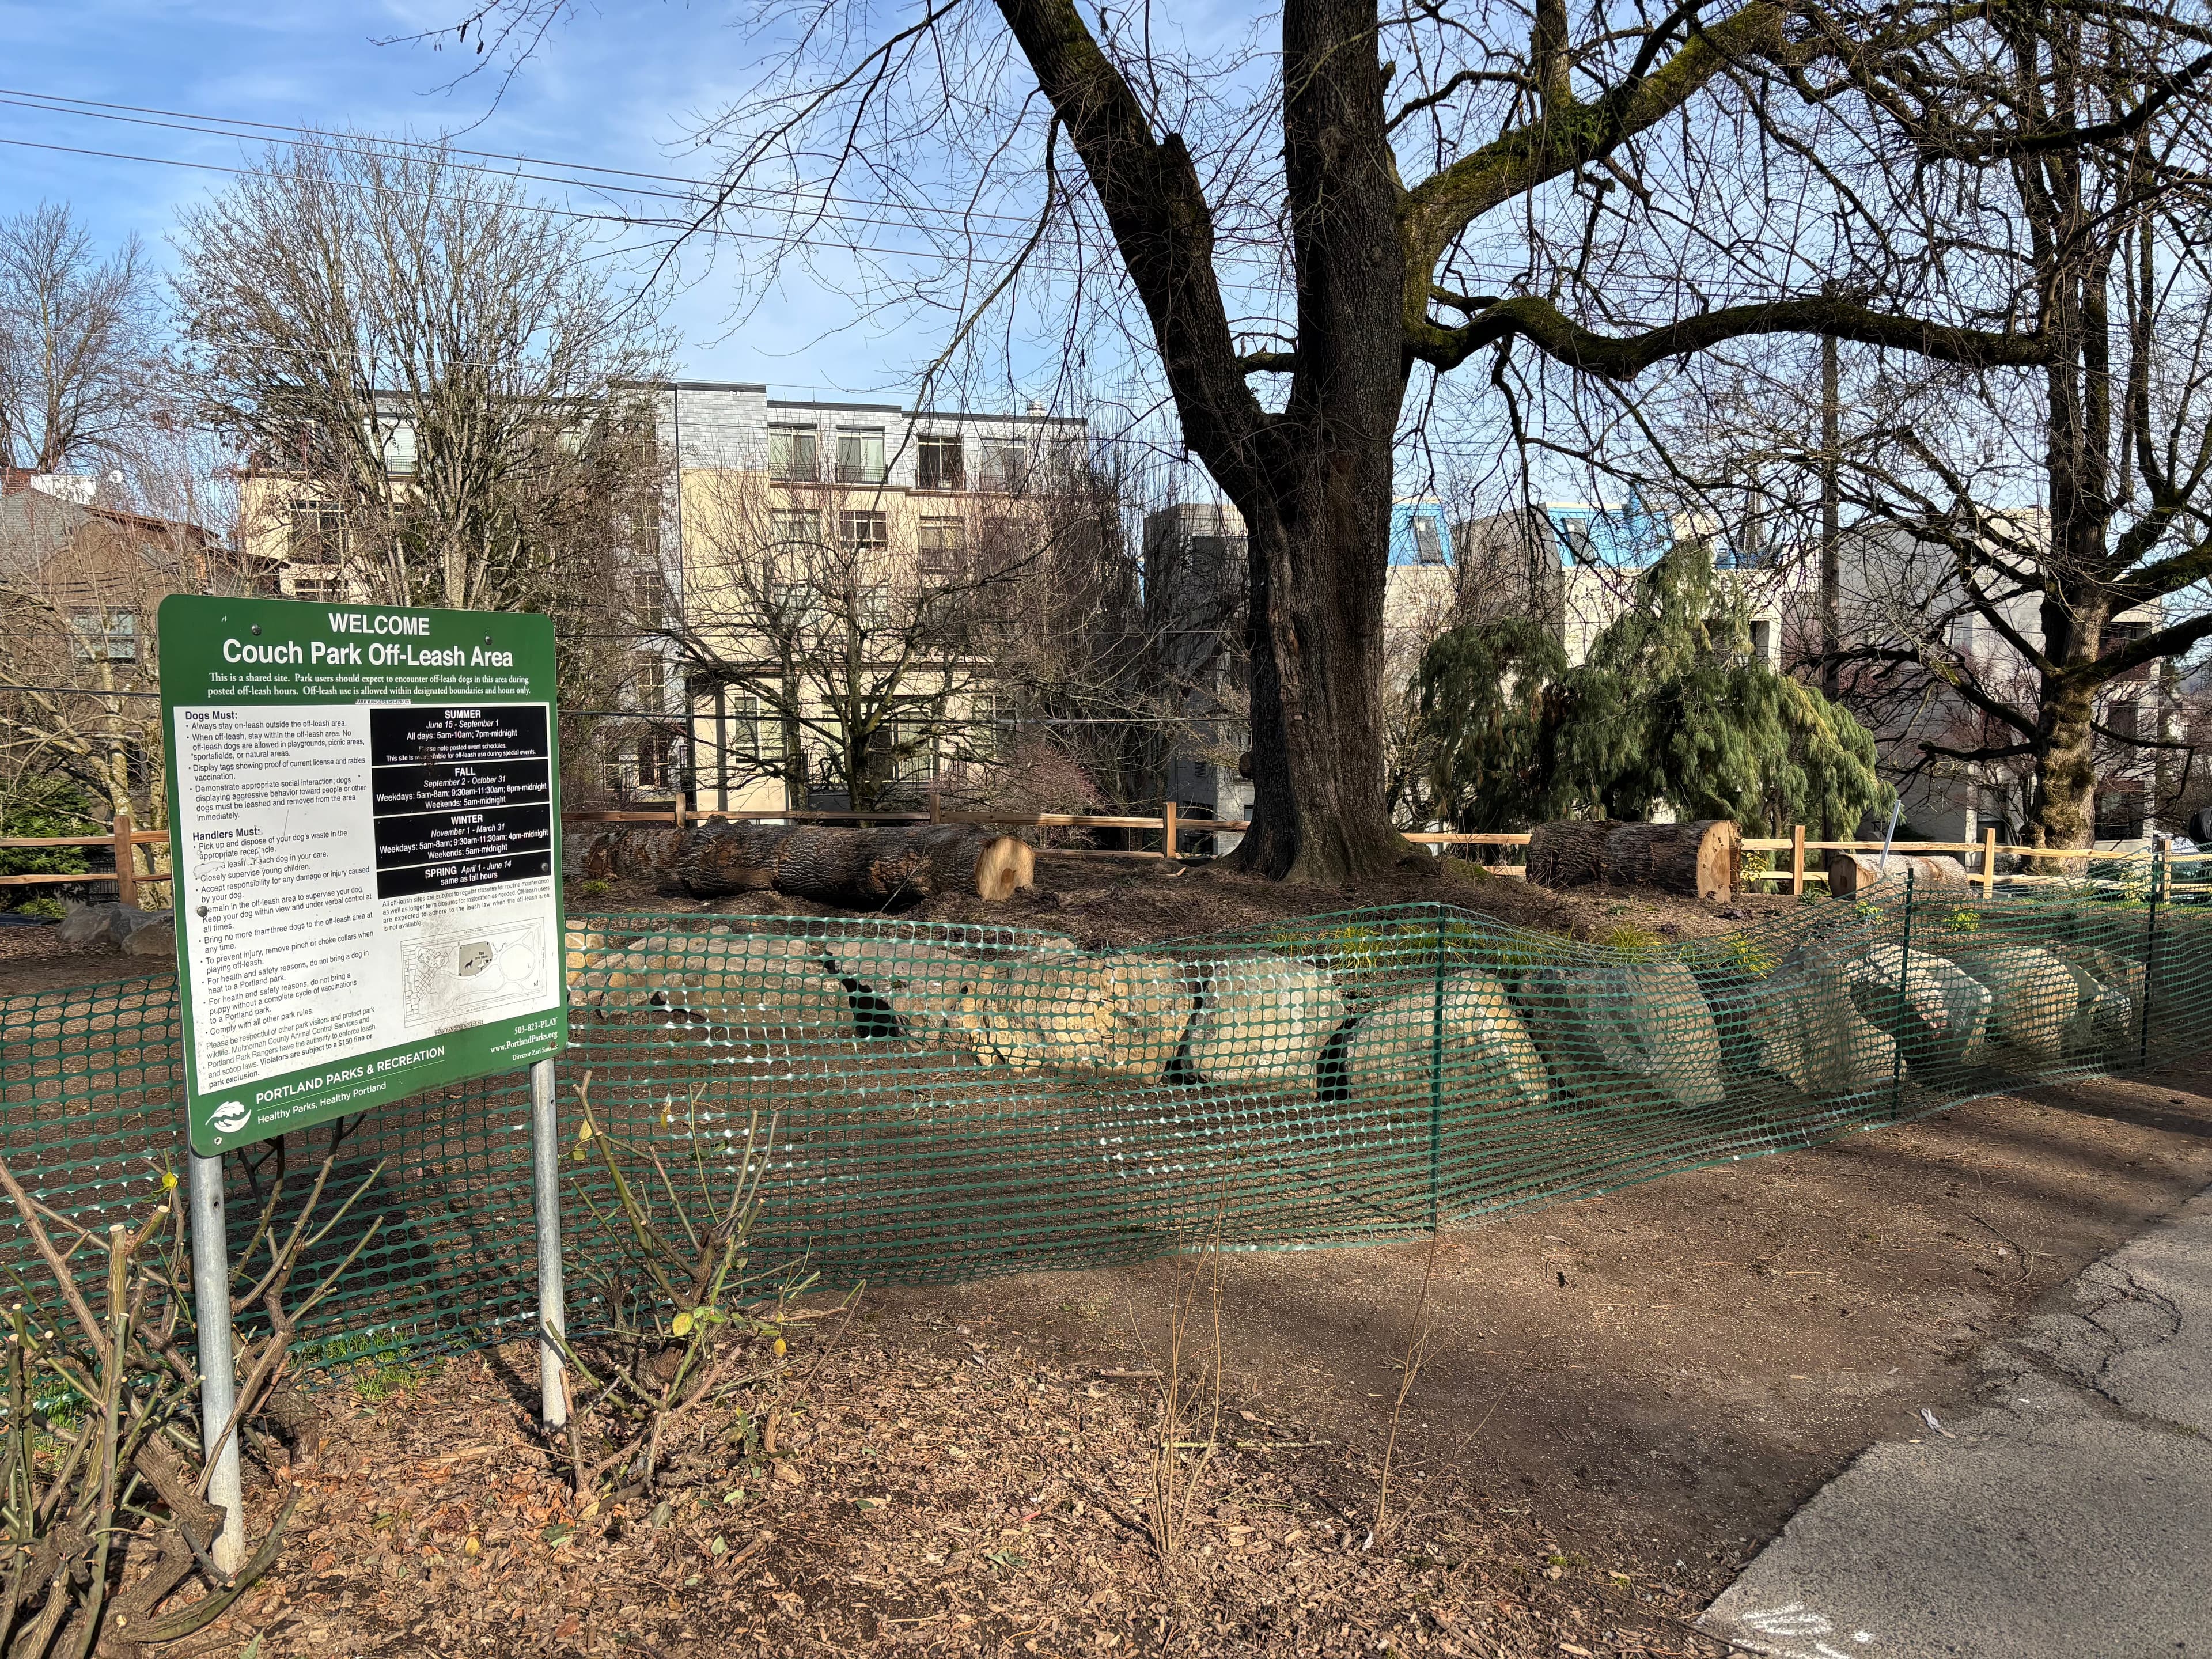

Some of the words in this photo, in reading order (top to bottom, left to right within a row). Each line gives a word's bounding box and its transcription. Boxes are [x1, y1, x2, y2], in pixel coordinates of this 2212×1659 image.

[328, 612, 430, 635] WELCOME
[222, 638, 302, 664] Couch
[310, 641, 362, 665] Park
[368, 643, 465, 666] Off-Leash
[470, 646, 513, 667] Area
[209, 672, 228, 681] This
[230, 673, 237, 681] is
[245, 672, 272, 682] shared
[274, 673, 290, 682] site.
[294, 673, 313, 682] Park
[335, 673, 359, 682] should
[361, 676, 384, 685] expect
[429, 674, 456, 683] off-leash
[457, 674, 472, 685] dogs
[482, 674, 494, 683] this
[508, 675, 529, 685] during
[207, 685, 235, 698] posted
[237, 685, 272, 695] off-leash
[274, 685, 298, 695] hours.
[302, 685, 337, 695] Off-leash
[353, 687, 359, 695] is
[361, 685, 388, 695] allowed
[389, 685, 411, 694] within
[413, 685, 448, 696] designated
[449, 685, 483, 694] boundaries
[484, 685, 496, 694] and
[498, 685, 515, 694] hours
[516, 685, 530, 696] only.
[185, 711, 210, 722] Dogs
[212, 711, 237, 719] Must:
[444, 709, 481, 719] SUMMER
[191, 722, 217, 731] Always
[218, 722, 233, 730] stay
[234, 721, 264, 729] on-leash
[426, 721, 442, 729] June
[445, 720, 453, 728] 15
[459, 719, 494, 729] September
[214, 732, 246, 740] off-leash,
[248, 732, 262, 741] stay
[296, 730, 324, 738] off-leash
[407, 732, 415, 740] All
[416, 732, 435, 741] days:
[437, 730, 474, 739] 5am-10am;
[475, 729, 517, 739] 7pm-midnight
[449, 744, 467, 752] posted
[454, 767, 476, 777] FALL
[423, 778, 460, 789] September
[471, 776, 497, 785] October
[376, 792, 415, 802] Weekdays:
[416, 790, 450, 799] 5am-8am;
[451, 786, 505, 796] 9:30am-11:30am;
[506, 782, 547, 794] 6pm-midnight
[425, 799, 461, 809] Weekends:
[463, 795, 506, 806] 5am-midnight
[450, 814, 483, 825] WINTER
[192, 830, 233, 841] Handlers
[236, 827, 260, 837] Must:
[431, 827, 465, 838] November
[476, 824, 495, 833] March
[497, 823, 505, 831] 31
[379, 843, 418, 854] Weekdays:
[419, 840, 452, 850] 5am-8am;
[453, 834, 507, 846] 9:30am-11:30am;
[508, 828, 548, 841] 4pm-midnight
[427, 848, 464, 859] Weekends:
[465, 843, 507, 855] 5am-midnight
[425, 866, 457, 879] SPRING
[461, 864, 476, 874] April
[504, 859, 512, 868] 14
[440, 877, 459, 885] same
[469, 873, 479, 881] fall
[210, 1022, 236, 1035] Comply
[237, 1020, 251, 1029] with
[253, 1018, 261, 1026] all
[262, 1015, 279, 1024] other
[281, 1011, 295, 1022] park
[297, 1009, 313, 1017] rules.
[514, 1017, 558, 1035] 503-823-PLAY
[490, 1031, 558, 1053] www.PortlandParks.org
[208, 1069, 221, 1078] and
[222, 1065, 241, 1075] scoop
[243, 1062, 259, 1070] laws.
[260, 1054, 289, 1065] Violators
[301, 1044, 324, 1055] subject
[338, 1037, 353, 1047] $150
[512, 1052, 531, 1060] Director
[531, 1047, 541, 1055] Zari
[209, 1078, 224, 1089] park
[225, 1071, 259, 1084] exclusion.
[256, 1077, 323, 1104] PORTLAND
[326, 1066, 363, 1085] PARKS
[366, 1063, 374, 1074] &
[377, 1046, 445, 1072] RECREATION
[257, 1109, 290, 1124] Healthy
[293, 1102, 317, 1114] Parks,
[320, 1092, 351, 1106] Healthy
[353, 1081, 386, 1097] Portland
